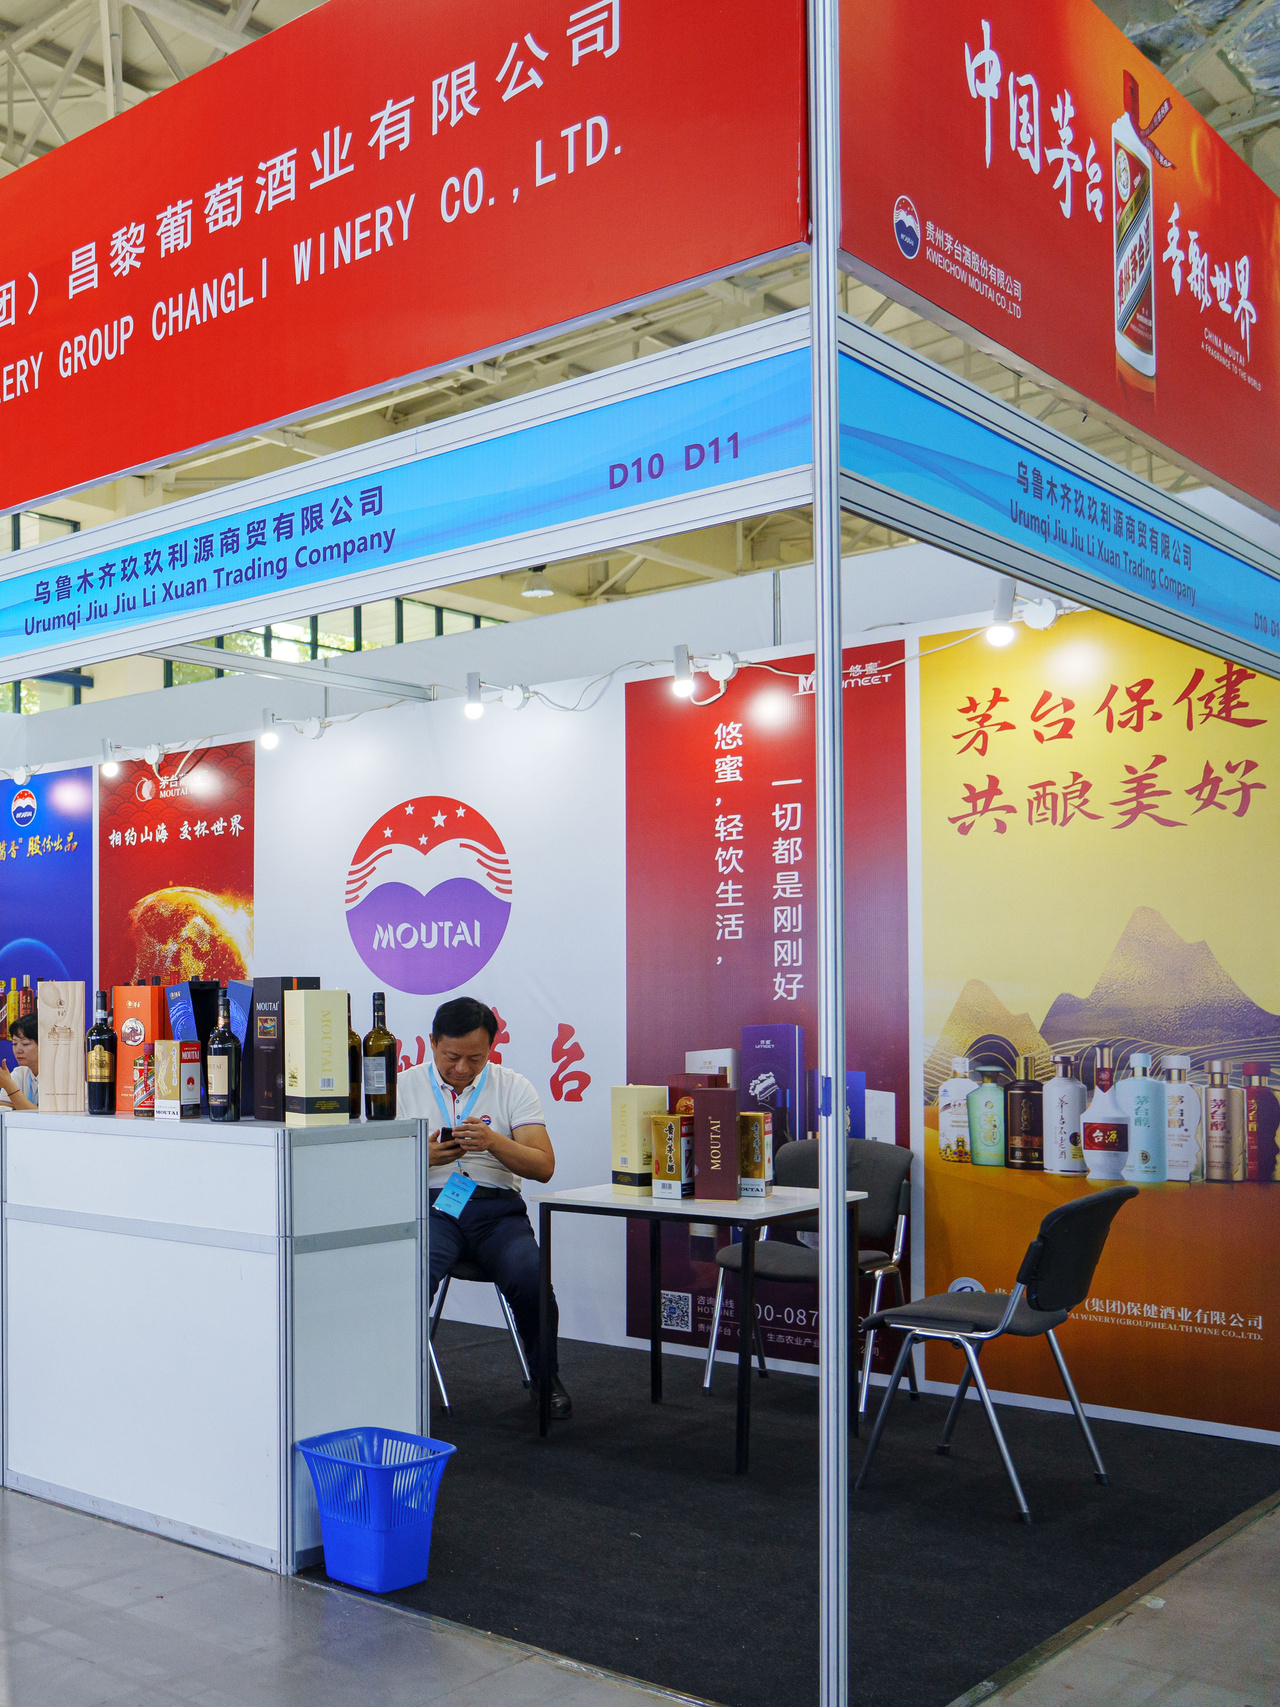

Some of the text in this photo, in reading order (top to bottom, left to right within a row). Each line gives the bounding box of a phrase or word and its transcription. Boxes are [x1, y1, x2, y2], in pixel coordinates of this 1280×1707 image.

[964, 19, 1103, 223] 中国茅台
[59, 315, 134, 379] GROUP
[152, 258, 268, 341] CHANGLI
[294, 193, 415, 286] WINERY
[925, 221, 1021, 301] 贵州茅台酒股份有限公司
[926, 246, 967, 284] KWEICHOW
[968, 273, 994, 302] MOUTAI
[1204, 327, 1245, 367] CHINA MOUTAI
[609, 432, 739, 490] D10 D11
[34, 485, 384, 605] 乌鲁木齐玖玖利源商贸有限公司
[1016, 461, 1193, 571] 乌鲁木齐玖玖利源商贸有限公司
[1010, 498, 1196, 607] Urumqi Jiu Jiu Li Xuan Trading Company
[24, 528, 396, 636] Urumqi Jiu Jiu Li Xuan Trading Company
[1254, 612, 1267, 634] D10
[952, 660, 1268, 757] 茅台保健
[159, 787, 188, 798] MOUTAI
[947, 754, 1267, 835] 共酿美好
[108, 814, 245, 848] 相约山海 交杯世界
[771, 778, 804, 1001] 一切都是刚刚好
[372, 919, 481, 951] MOUTAI
[256, 1002, 278, 1010] MOUTAI
[321, 1010, 332, 1073] MOUTAI
[710, 1120, 721, 1170] MOUTAI
[697, 1305, 735, 1318] HOTINE
[1084, 1297, 1264, 1330] (集团)保健酒业有限公司
[1194, 1326, 1220, 1336] WINE
